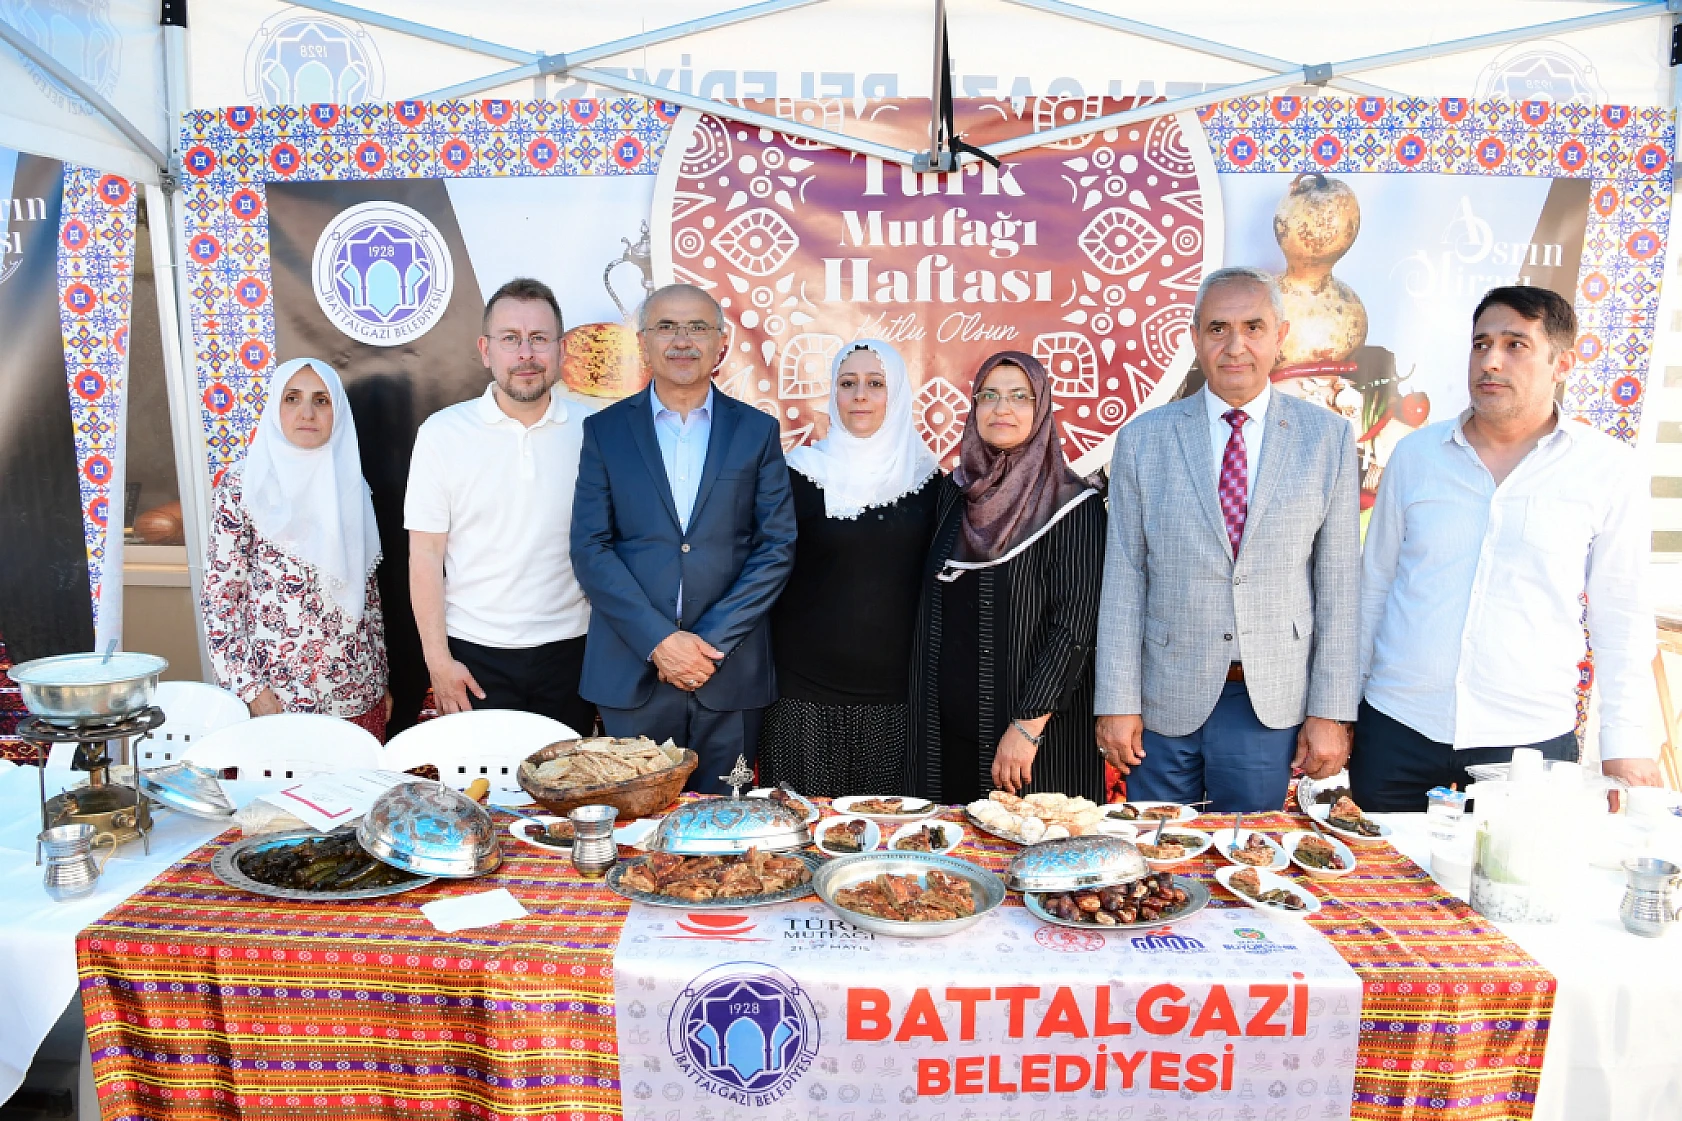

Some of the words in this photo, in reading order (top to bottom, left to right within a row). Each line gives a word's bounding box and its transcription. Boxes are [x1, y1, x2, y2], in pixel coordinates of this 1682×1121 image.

[368, 245, 395, 257] 1928
[837, 206, 1039, 259] Mutfağı
[820, 253, 1053, 303] Haftası
[324, 292, 391, 339] BATTALGAZİ
[936, 311, 1019, 342] Olsun
[728, 1002, 761, 1016] 1928
[845, 971, 1309, 1042] BATTALGAZİ
[675, 1053, 751, 1107] BATTALGAZİ
[755, 1051, 816, 1107] BELEDİYESİ
[916, 1043, 1235, 1096] BELEDİYESİ
